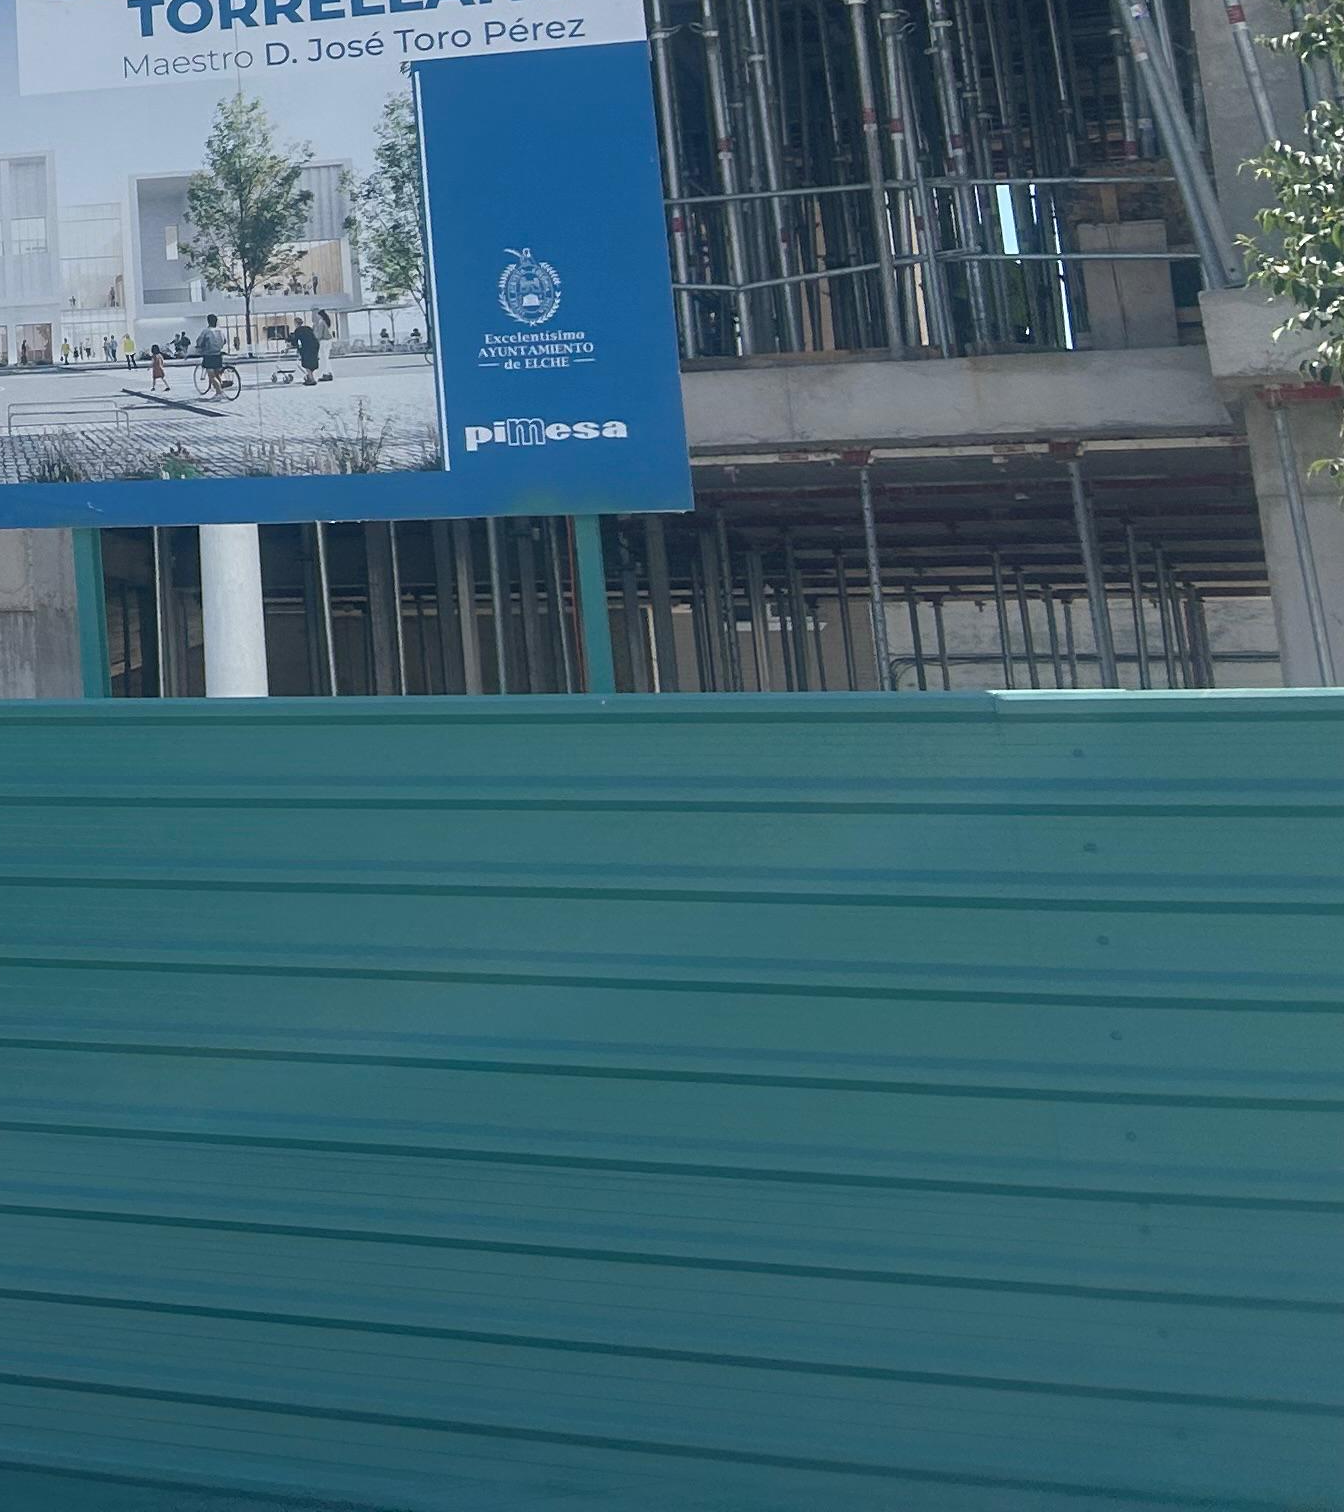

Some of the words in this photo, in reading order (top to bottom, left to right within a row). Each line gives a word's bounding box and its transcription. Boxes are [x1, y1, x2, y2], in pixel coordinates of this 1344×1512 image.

[123, 49, 254, 79] Maestro
[265, 41, 298, 66] D.
[307, 31, 385, 63] José
[393, 28, 472, 54] Toro
[484, 17, 586, 46] Pérez
[478, 342, 594, 358] AYUNTAMIENTO
[504, 358, 521, 369] de
[524, 356, 570, 369] ELCHE
[465, 417, 628, 452] pimesa
